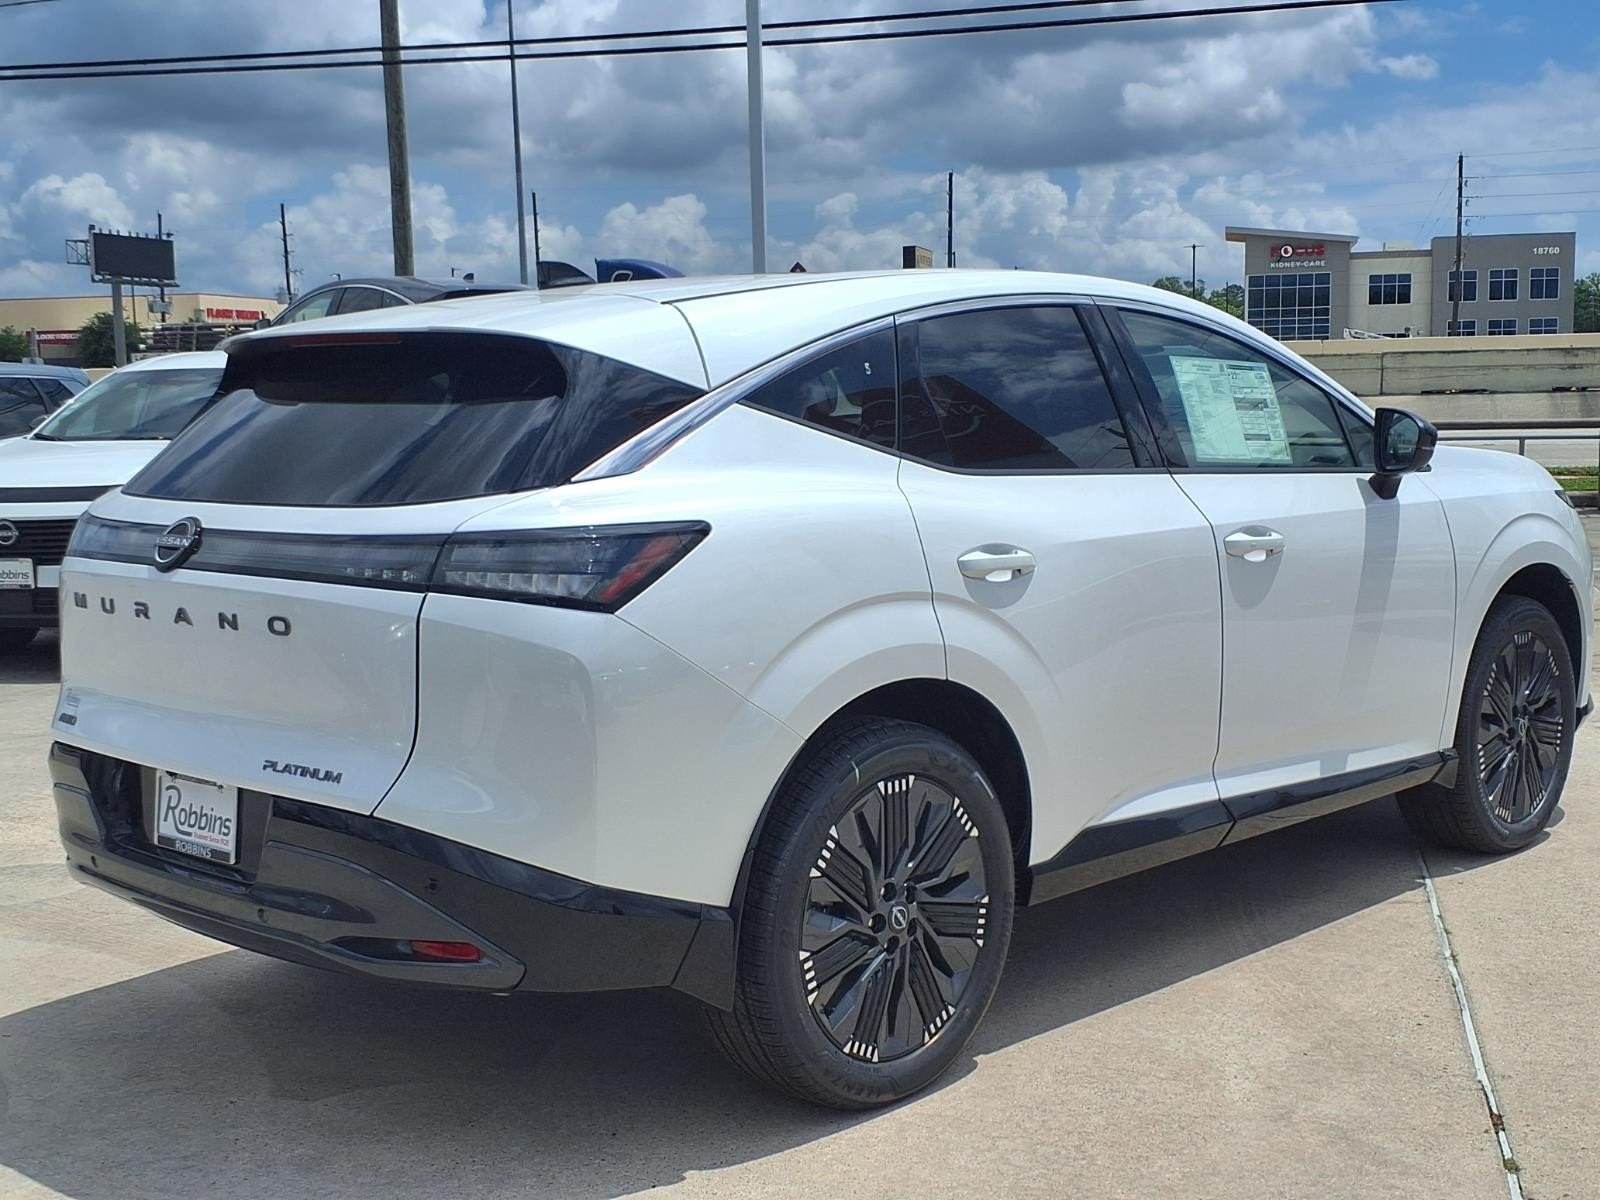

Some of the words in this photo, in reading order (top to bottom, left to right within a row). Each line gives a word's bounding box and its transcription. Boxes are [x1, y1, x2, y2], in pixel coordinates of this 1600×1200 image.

[1532, 246, 1560, 255] 18760
[864, 362, 872, 375] S
[0, 569, 30, 580] bbins
[73, 591, 292, 637] MURANO
[262, 759, 343, 784] PLATINUM
[163, 784, 232, 837] Robbins
[175, 840, 212, 858] ROBBINS
